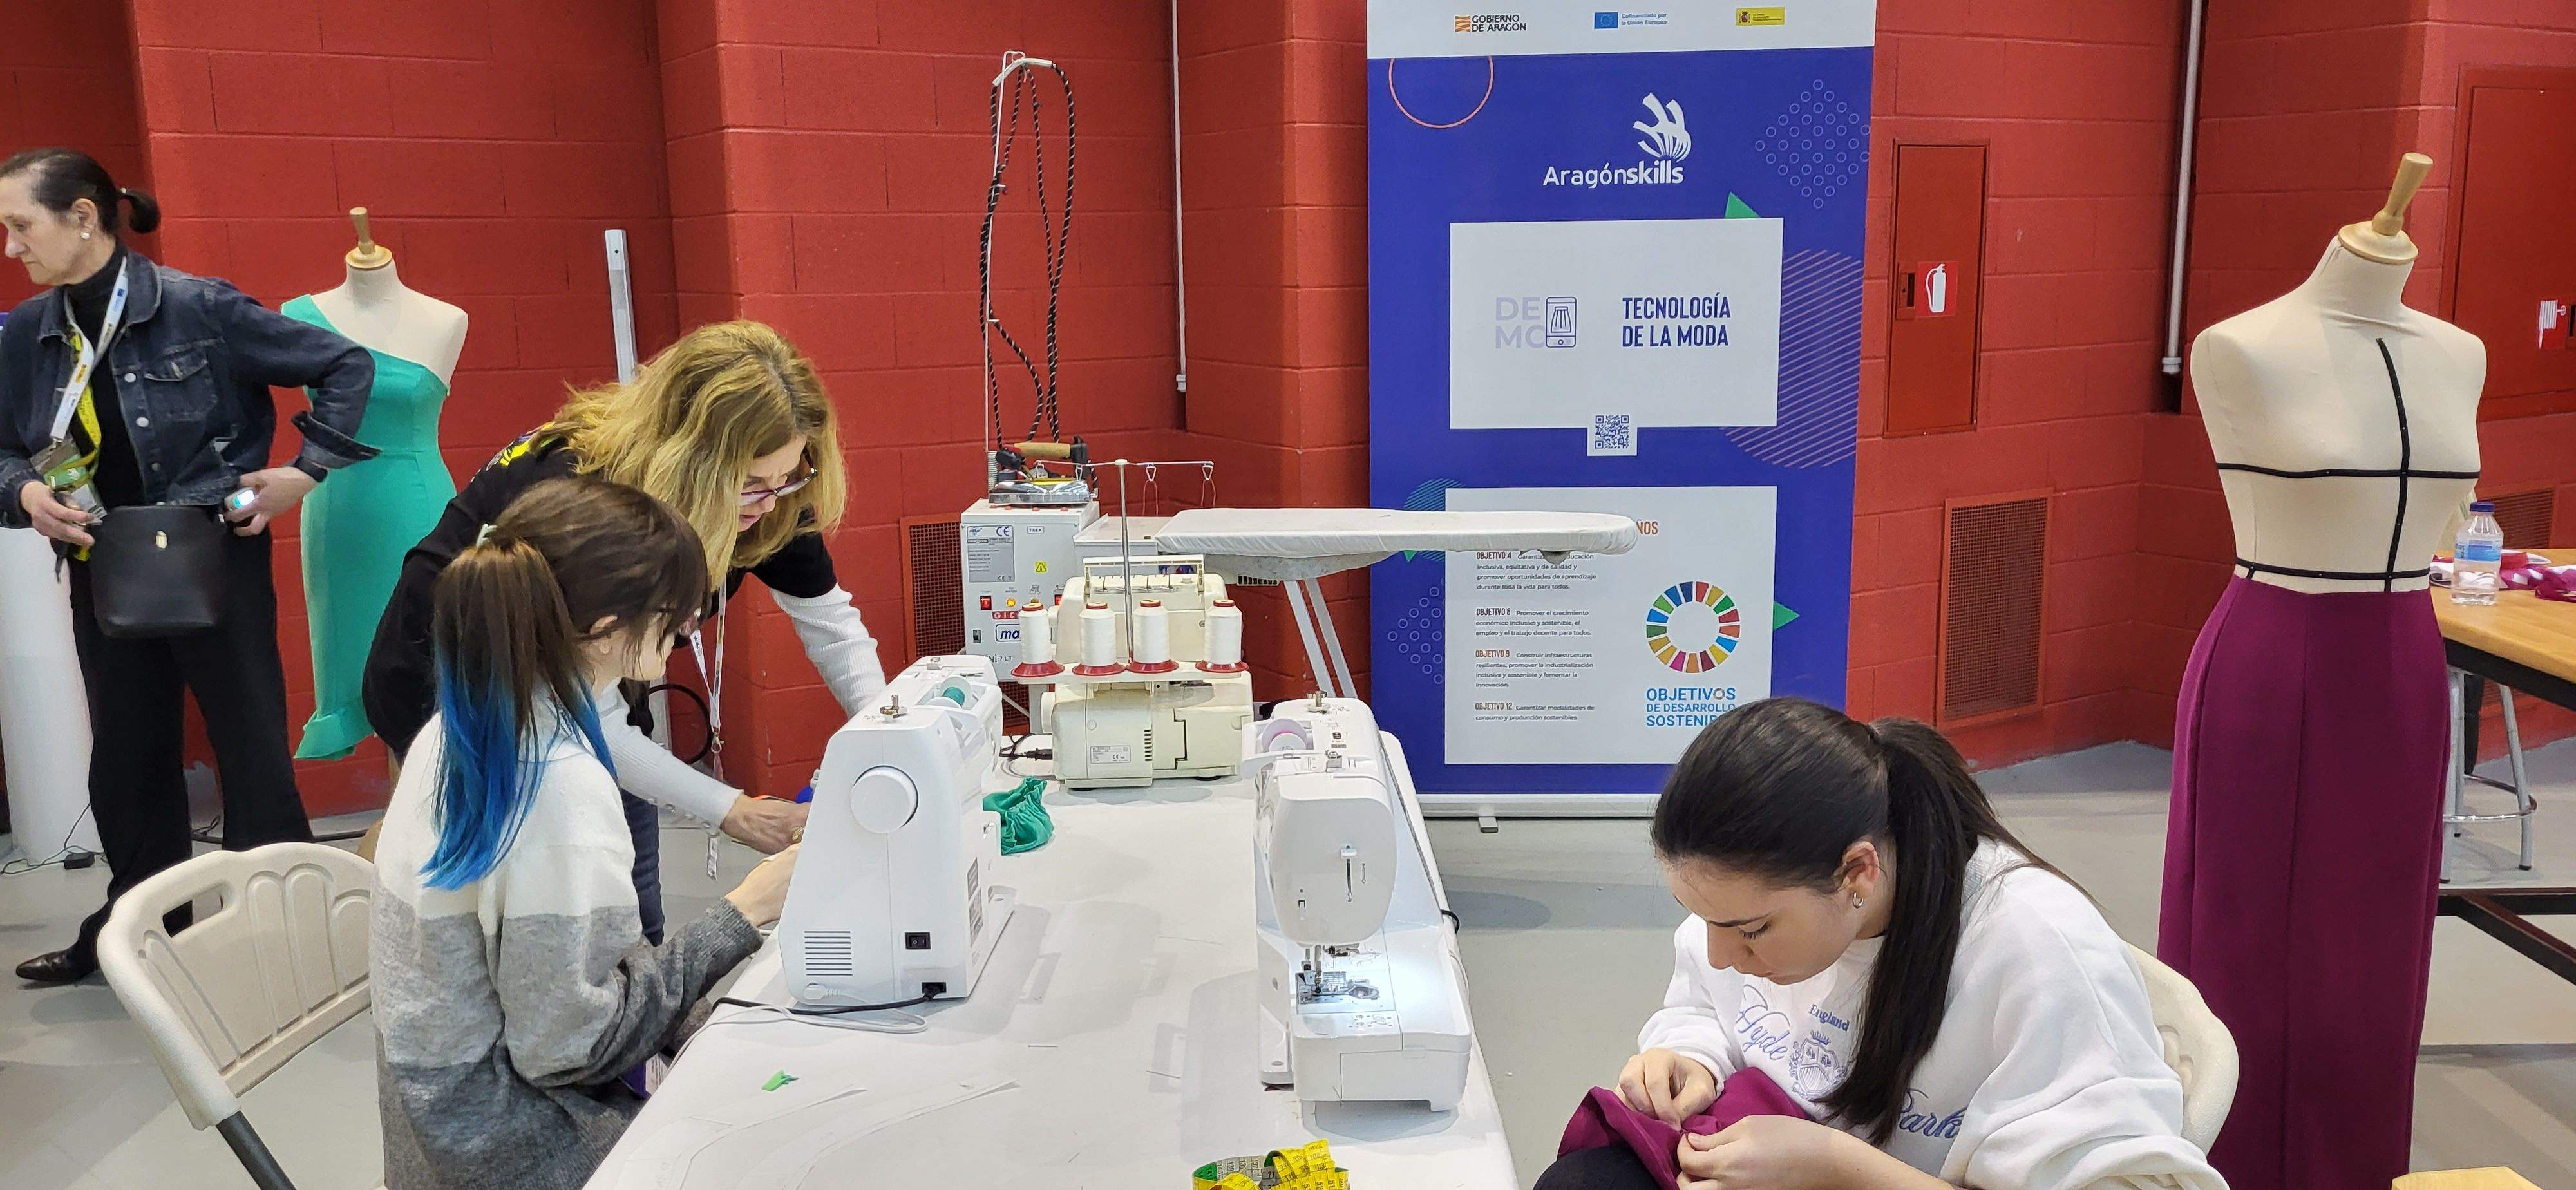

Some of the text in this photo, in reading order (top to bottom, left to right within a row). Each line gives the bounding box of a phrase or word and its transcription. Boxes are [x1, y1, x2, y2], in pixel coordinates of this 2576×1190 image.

[1472, 15, 1520, 23] GOBIERNO
[1543, 160, 1684, 189] Aragónskills
[1495, 297, 1540, 321] DE
[1622, 292, 1731, 319] TECNOLOGÍA
[1622, 325, 1728, 347] DE LA MODA
[1636, 519, 1658, 534] ÑOS
[1647, 688, 1736, 701] OBJETIVOS
[1647, 704, 1736, 712] DE DESARROLLO
[1647, 715, 1716, 726] SOSTENI
[1736, 985, 1790, 1061] Hyde
[1808, 1003, 1850, 1032] England
